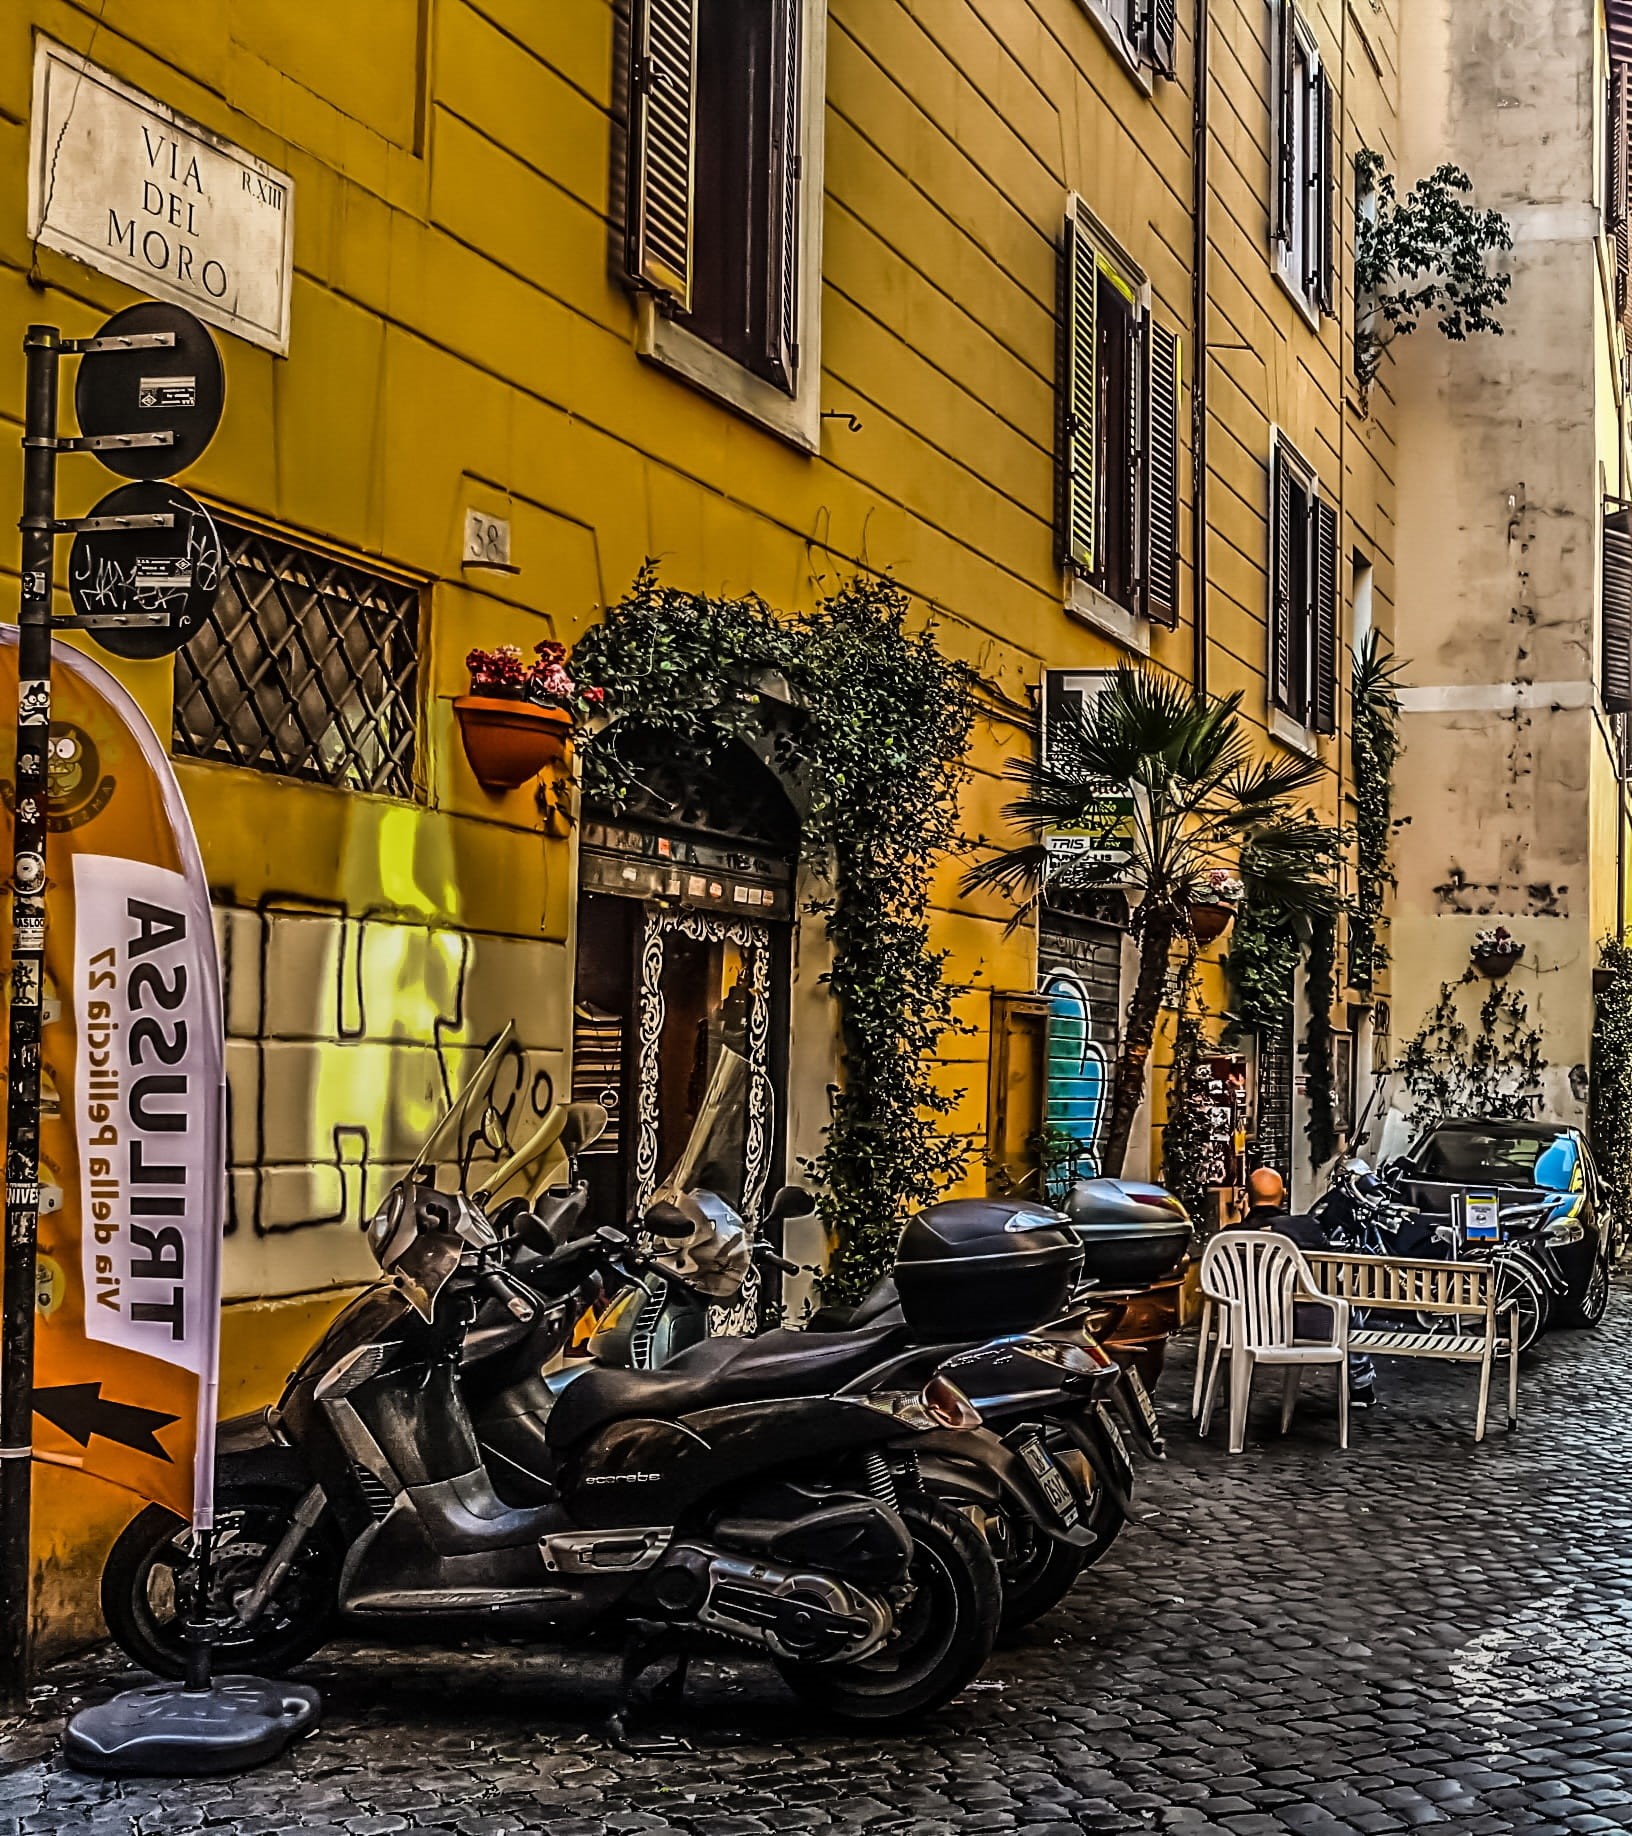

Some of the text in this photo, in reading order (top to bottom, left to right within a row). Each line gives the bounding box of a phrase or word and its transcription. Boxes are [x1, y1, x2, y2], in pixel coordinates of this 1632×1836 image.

[141, 126, 204, 194] VIA
[144, 180, 199, 238] DEL
[242, 171, 282, 211] R.XIII
[107, 208, 228, 298] MORO
[1051, 838, 1085, 849] TRIS
